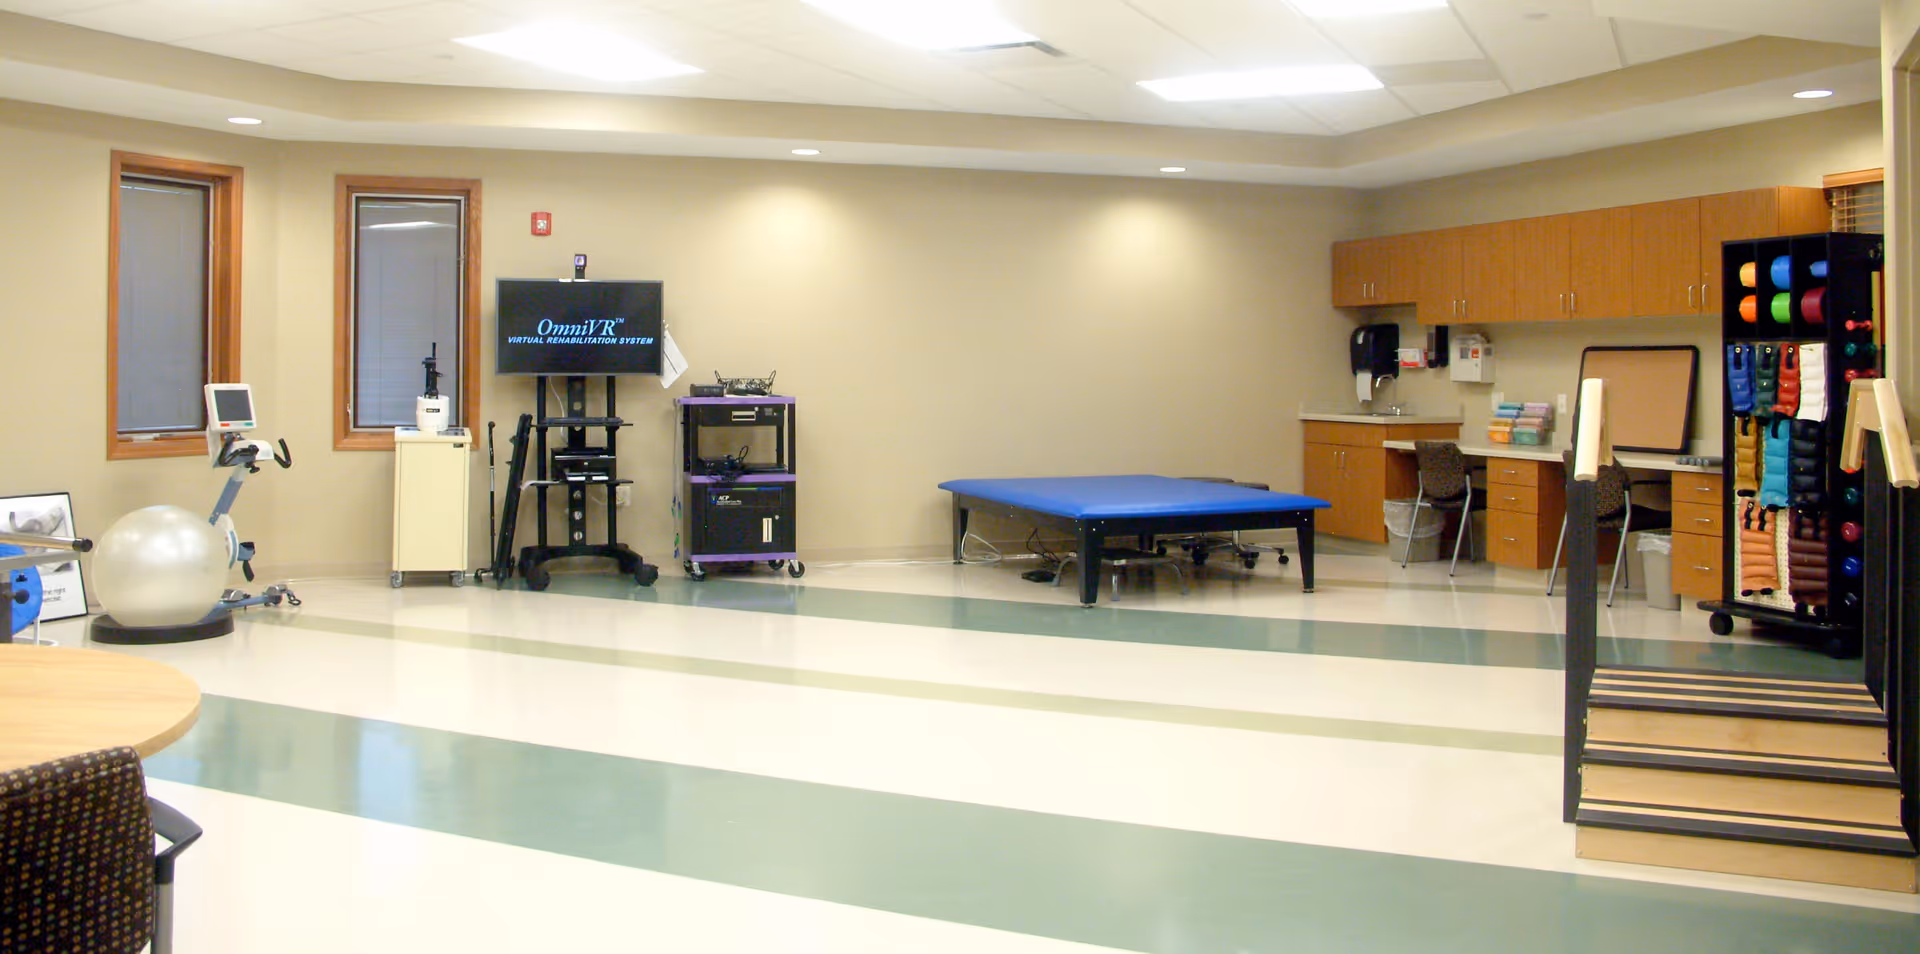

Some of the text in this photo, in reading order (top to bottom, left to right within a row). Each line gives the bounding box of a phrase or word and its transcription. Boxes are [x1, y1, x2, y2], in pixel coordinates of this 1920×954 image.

[508, 336, 654, 345] VIRTUAL REHABILITATION SYSTEM
